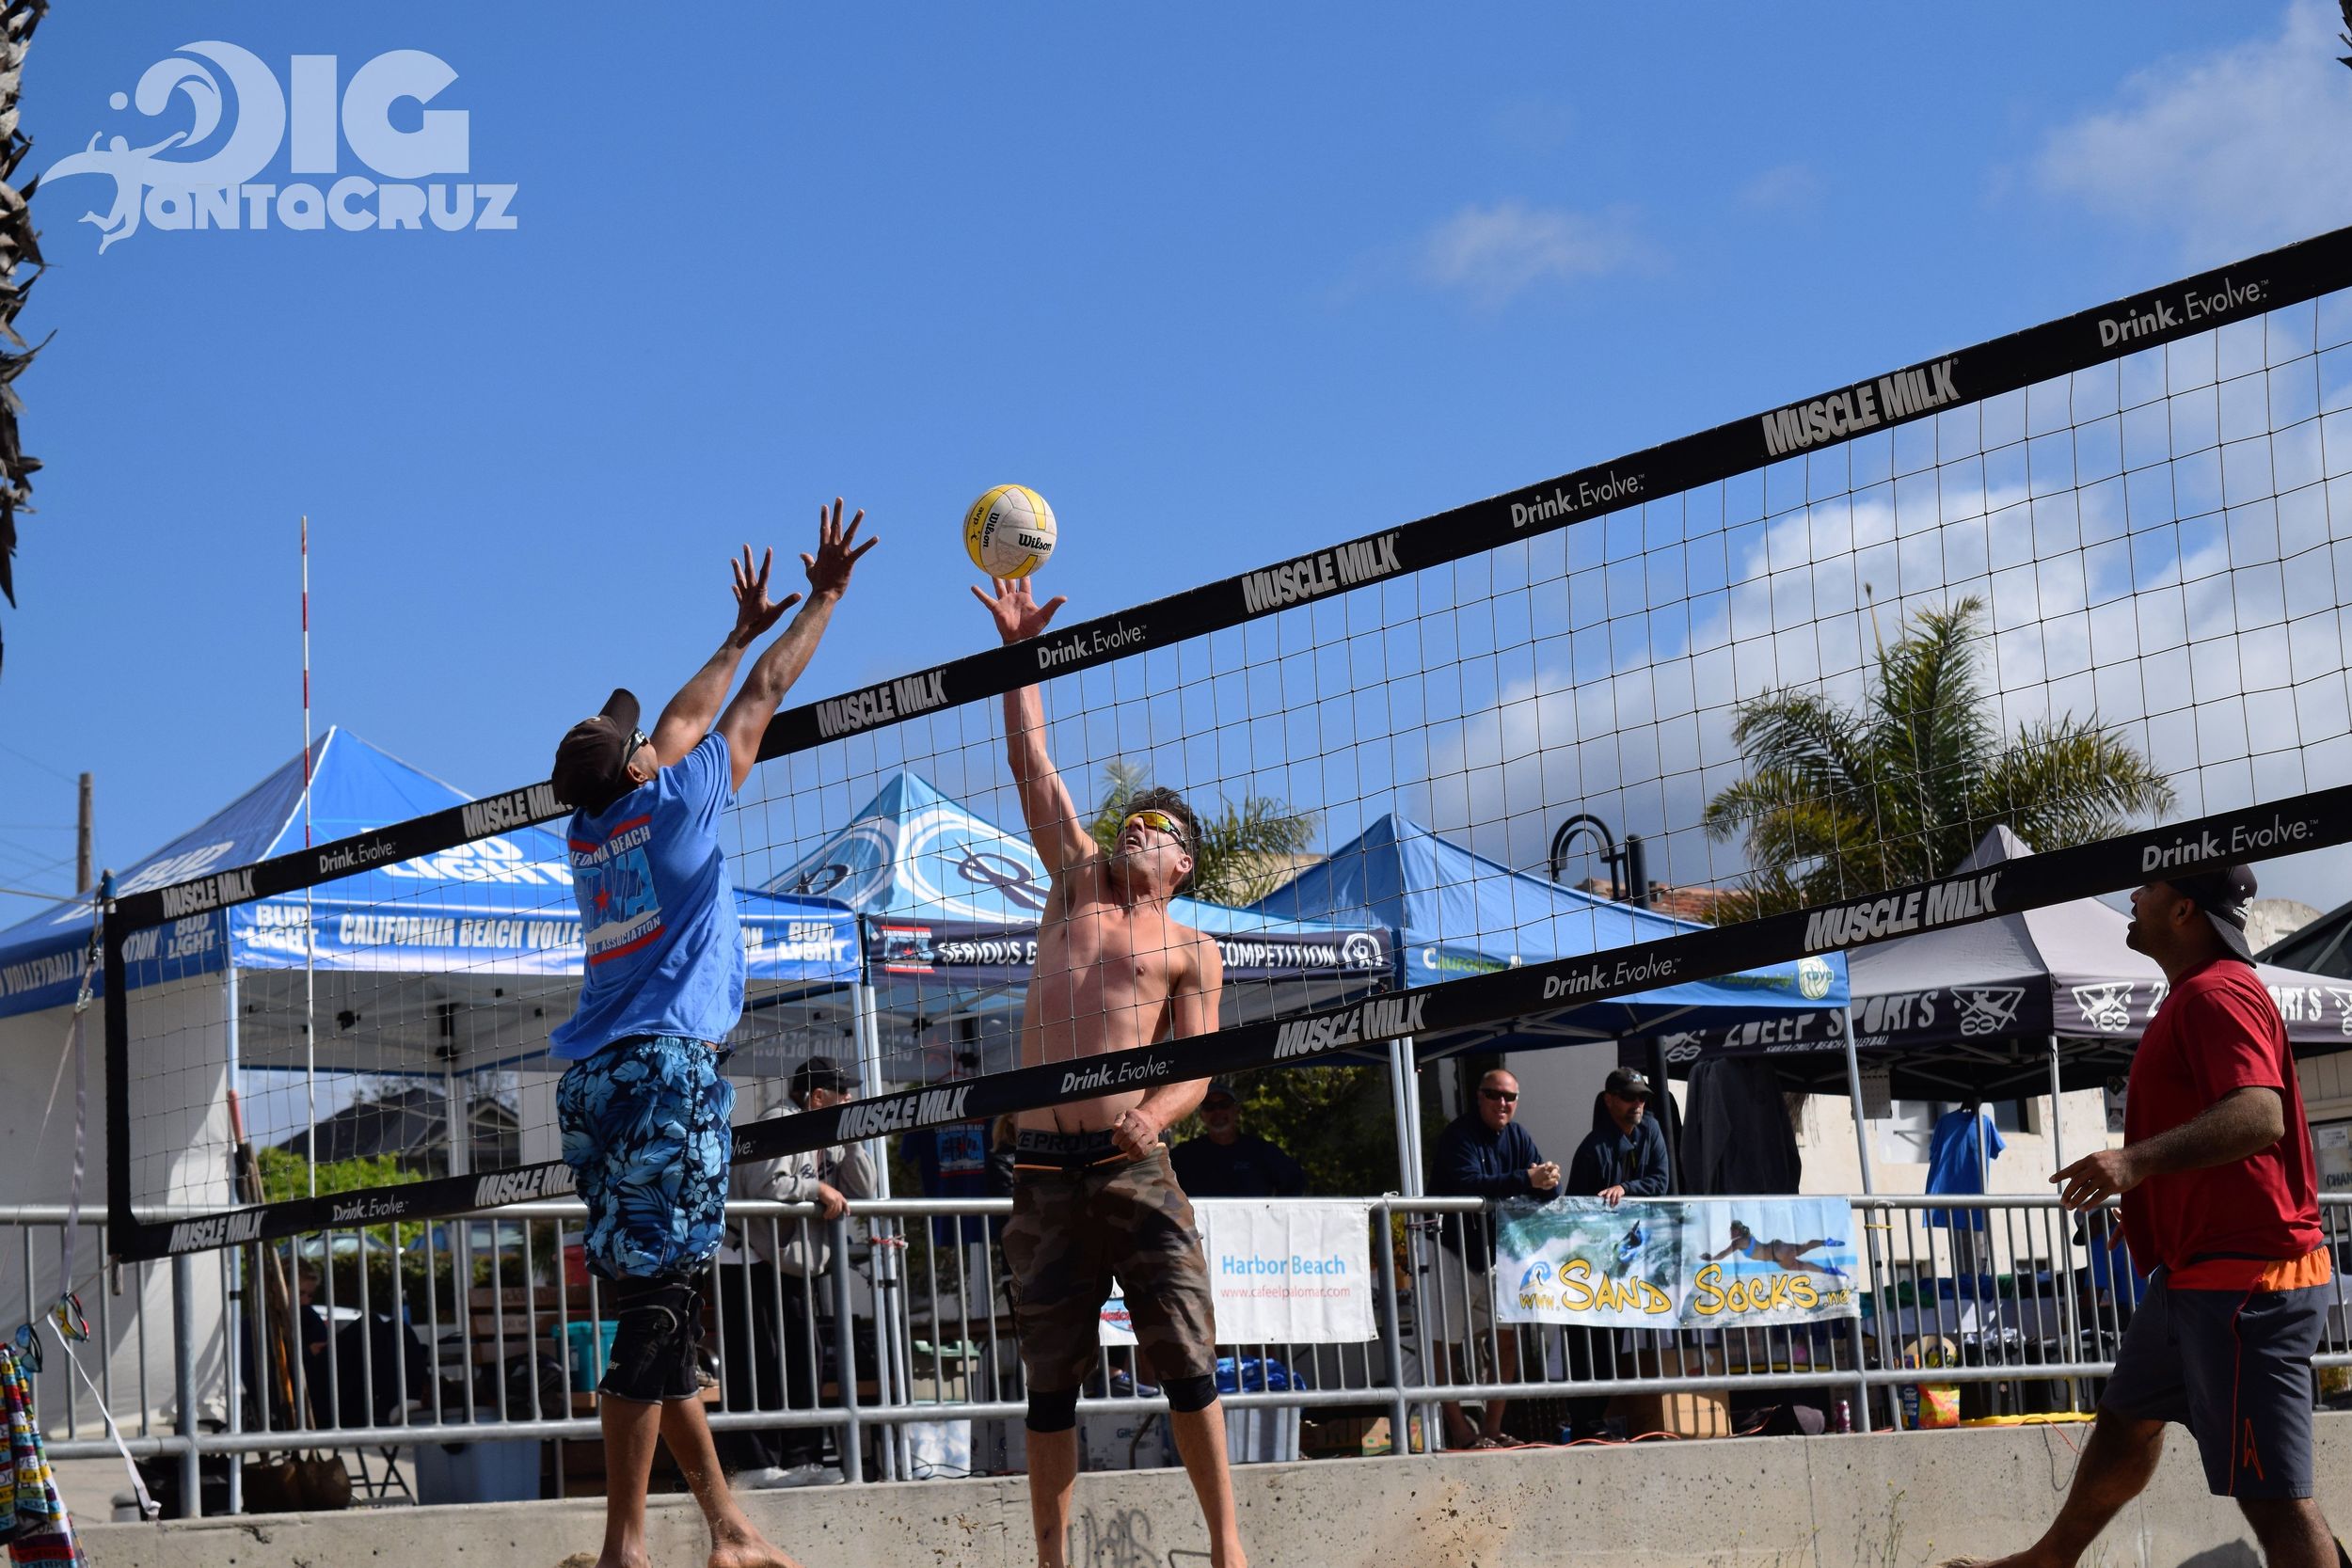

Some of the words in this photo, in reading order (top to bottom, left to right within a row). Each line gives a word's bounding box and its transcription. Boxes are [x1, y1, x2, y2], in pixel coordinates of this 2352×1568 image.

[2098, 300, 2184, 348] Drink.
[1762, 388, 1880, 457] MUSCLE
[1879, 358, 1961, 421] MILK
[1511, 487, 1578, 529] Drink.
[983, 513, 999, 547] Wilson
[1019, 533, 1052, 551] Wilson
[1242, 552, 1337, 613] MUSCLE
[1336, 533, 1401, 586] MILK
[1037, 634, 1092, 670] Drink.
[816, 688, 895, 738] MUSCLE
[895, 670, 947, 717] MILK
[462, 799, 528, 838] MUSCLE
[527, 784, 573, 820] MIL
[611, 825, 652, 855] BEACH
[2141, 830, 2226, 873] Drink.
[319, 847, 358, 875] Drink.
[161, 878, 217, 919] MUSCLE
[217, 868, 256, 905] MILK
[255, 904, 309, 927] BUD
[1804, 891, 1923, 953] MUSCLE
[1924, 873, 1999, 927] MILK
[168, 930, 216, 958] LIGHT
[246, 927, 319, 949] LIGHT
[340, 914, 454, 947] CALIFORNIA
[458, 917, 524, 949] BEACH
[789, 922, 834, 942] BUD
[779, 942, 845, 962] LIGHT
[938, 942, 1021, 965] SERIOUS
[3, 949, 74, 994] VOLLEYBALL
[1543, 964, 1610, 1000] Drink.
[1273, 1007, 1363, 1059] MUSCLE
[1361, 995, 1427, 1041] MILK
[1060, 1063, 1116, 1094] Drink.
[836, 1096, 917, 1141] MUSCLE
[915, 1085, 969, 1126] MILK
[475, 1168, 544, 1207] MUSCLE
[332, 1198, 367, 1223] Drink.
[168, 1219, 229, 1254] MUSCLE
[227, 1211, 263, 1243] MILK
[1222, 1253, 1287, 1275] Harbor
[1292, 1253, 1345, 1275] Beach
[1220, 1285, 1351, 1300] www.cafeelpalomar.com
